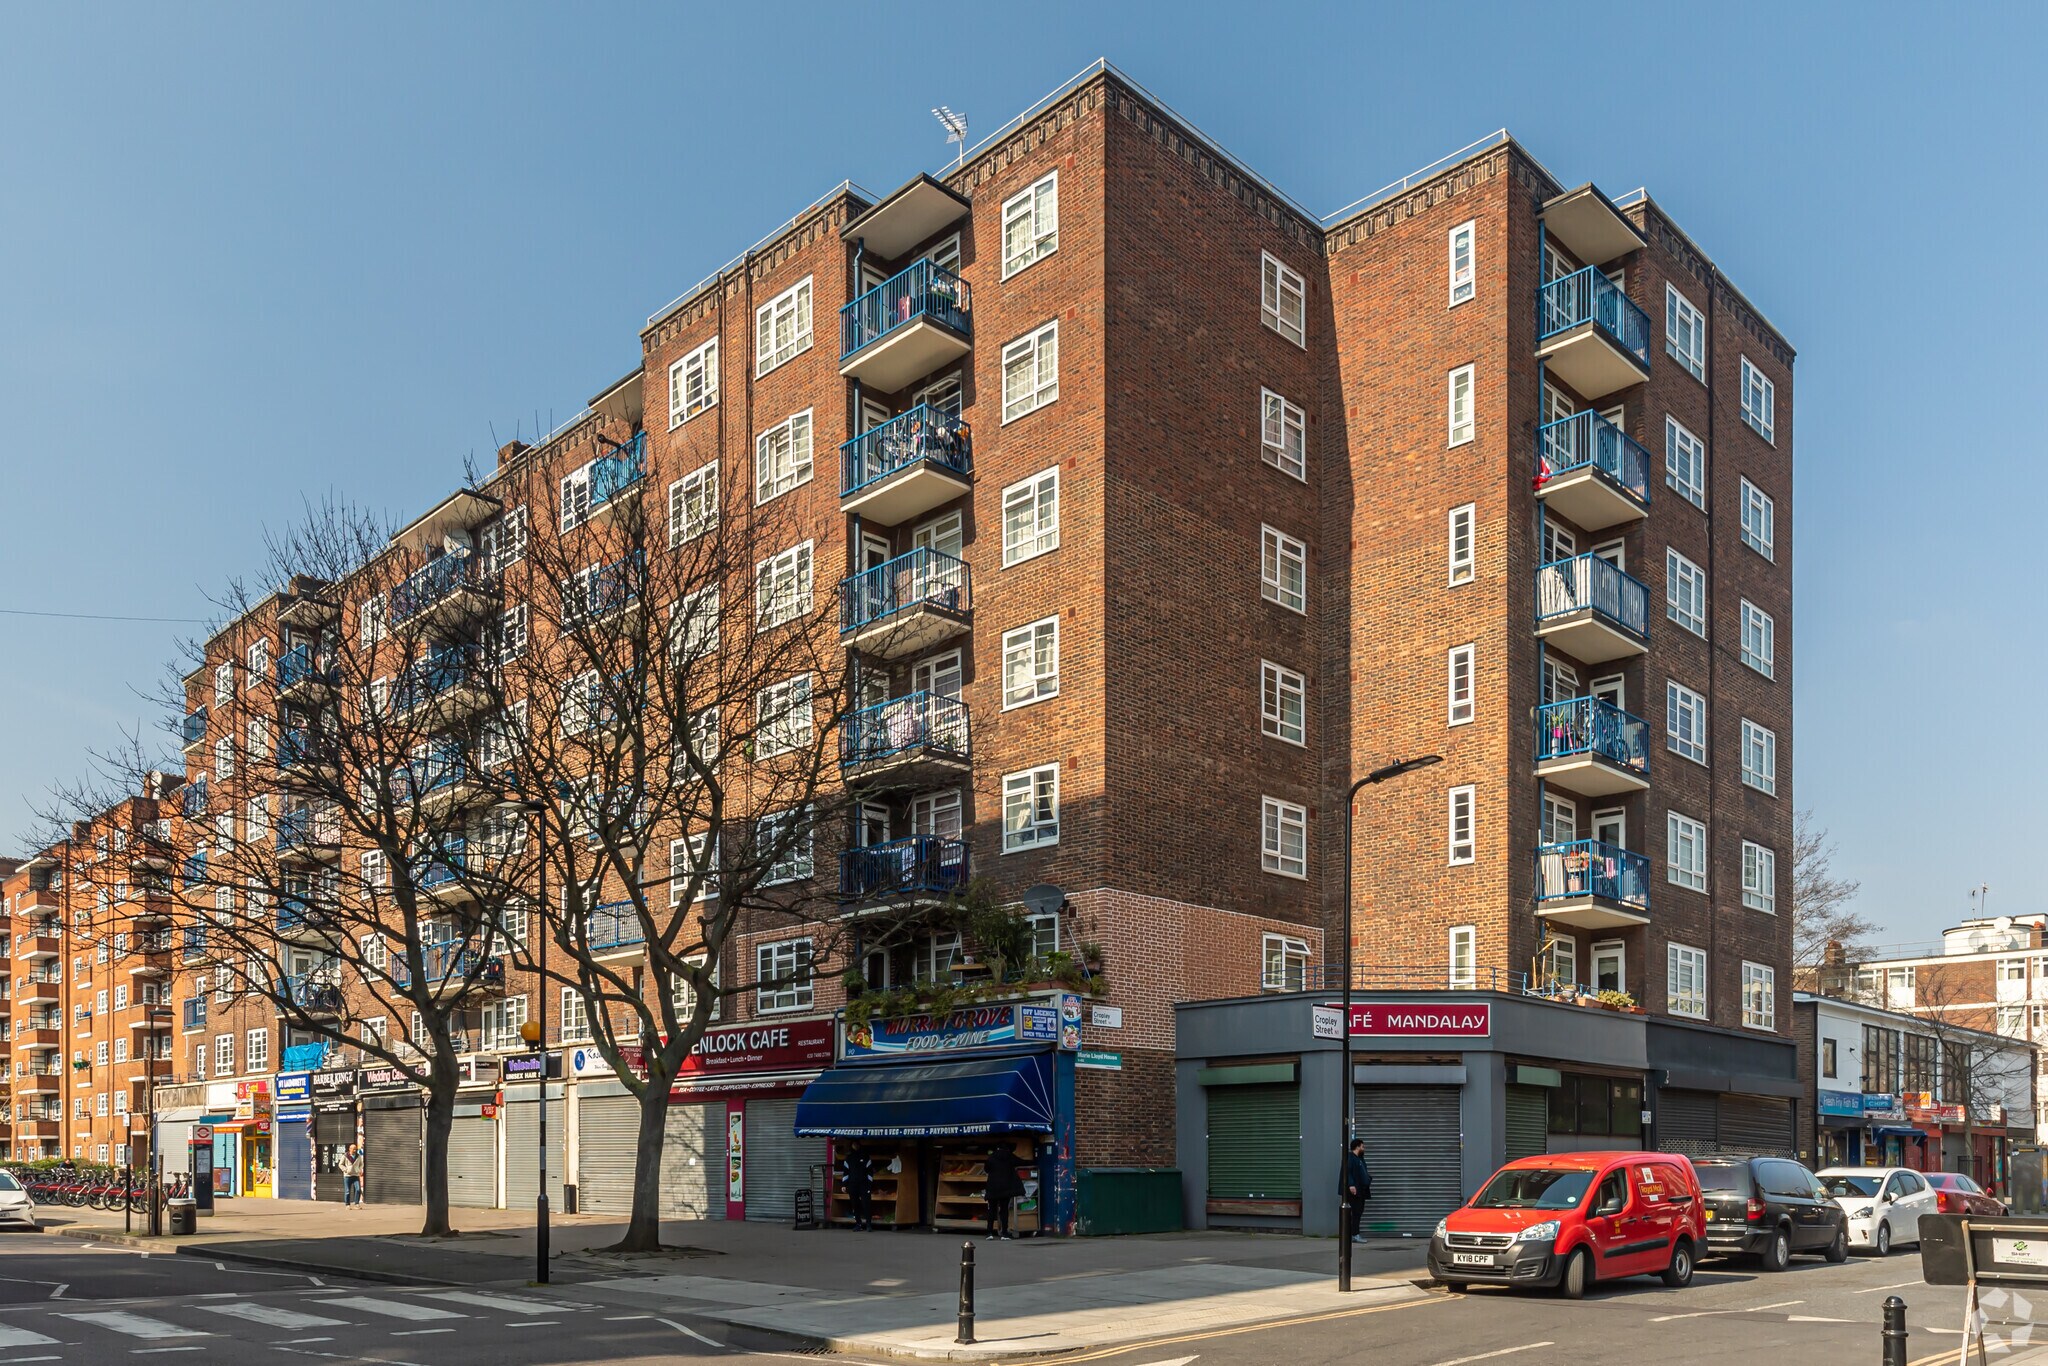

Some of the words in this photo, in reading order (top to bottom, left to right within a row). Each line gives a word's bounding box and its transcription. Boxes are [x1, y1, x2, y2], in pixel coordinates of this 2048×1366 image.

[953, 1004, 1012, 1032] GROVE
[1034, 1009, 1056, 1017] LICENCE
[1093, 1011, 1110, 1020] Cropley
[1314, 1014, 1338, 1027] Cropley
[1387, 1014, 1485, 1029] MANDALAY
[1315, 1024, 1334, 1035] Street
[691, 1032, 747, 1055] ENLOCK
[749, 1028, 789, 1050] CAFE
[797, 1038, 825, 1047] RESTAURANT
[905, 1033, 941, 1050] FOOD
[954, 1030, 991, 1047] WINE
[705, 1057, 728, 1065] Breakfast
[746, 1054, 764, 1062] Dinner
[313, 1073, 334, 1085] BARBER
[334, 1071, 354, 1085] KINGZ
[366, 1069, 391, 1083] Wedding
[505, 1072, 524, 1080] UNISEX
[524, 1071, 537, 1079] HAIR
[1823, 1095, 1836, 1107] Fresh
[833, 1128, 863, 1136] GROCERIES
[867, 1128, 883, 1136] FRUIT
[888, 1128, 899, 1136] VEG
[903, 1128, 925, 1136] OYSTER
[929, 1126, 959, 1135] PAYPOINT
[963, 1124, 991, 1133] LOTTERY
[1640, 1185, 1653, 1195] Royal
[1652, 1183, 1663, 1193] Mail
[1457, 1254, 1473, 1263] KY18
[1474, 1254, 1489, 1264] CPF
